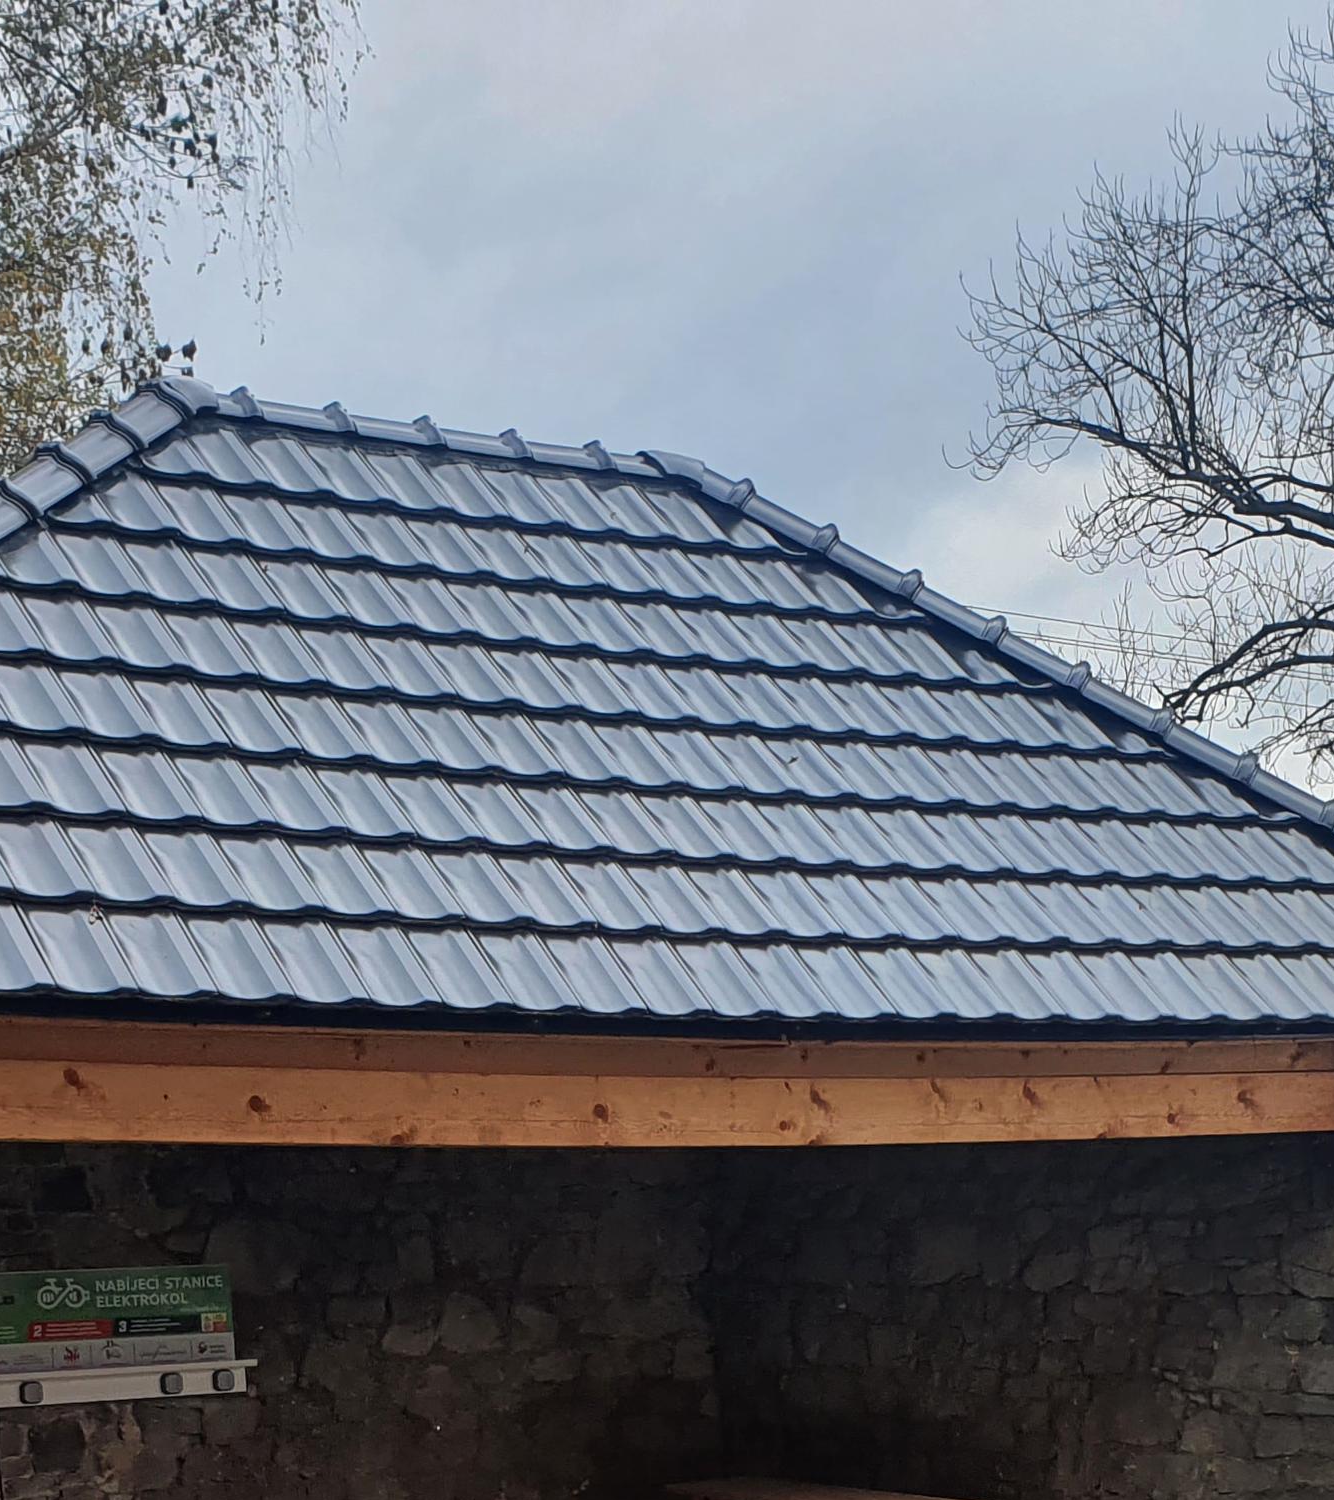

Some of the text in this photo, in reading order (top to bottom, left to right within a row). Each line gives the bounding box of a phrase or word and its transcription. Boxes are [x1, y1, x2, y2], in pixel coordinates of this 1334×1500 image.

[95, 1275, 223, 1292] NABÍJECÍ STANICE
[95, 1293, 189, 1308] ELEKTROKOL
[33, 1325, 42, 1338] 2
[118, 1320, 127, 1333] 3
